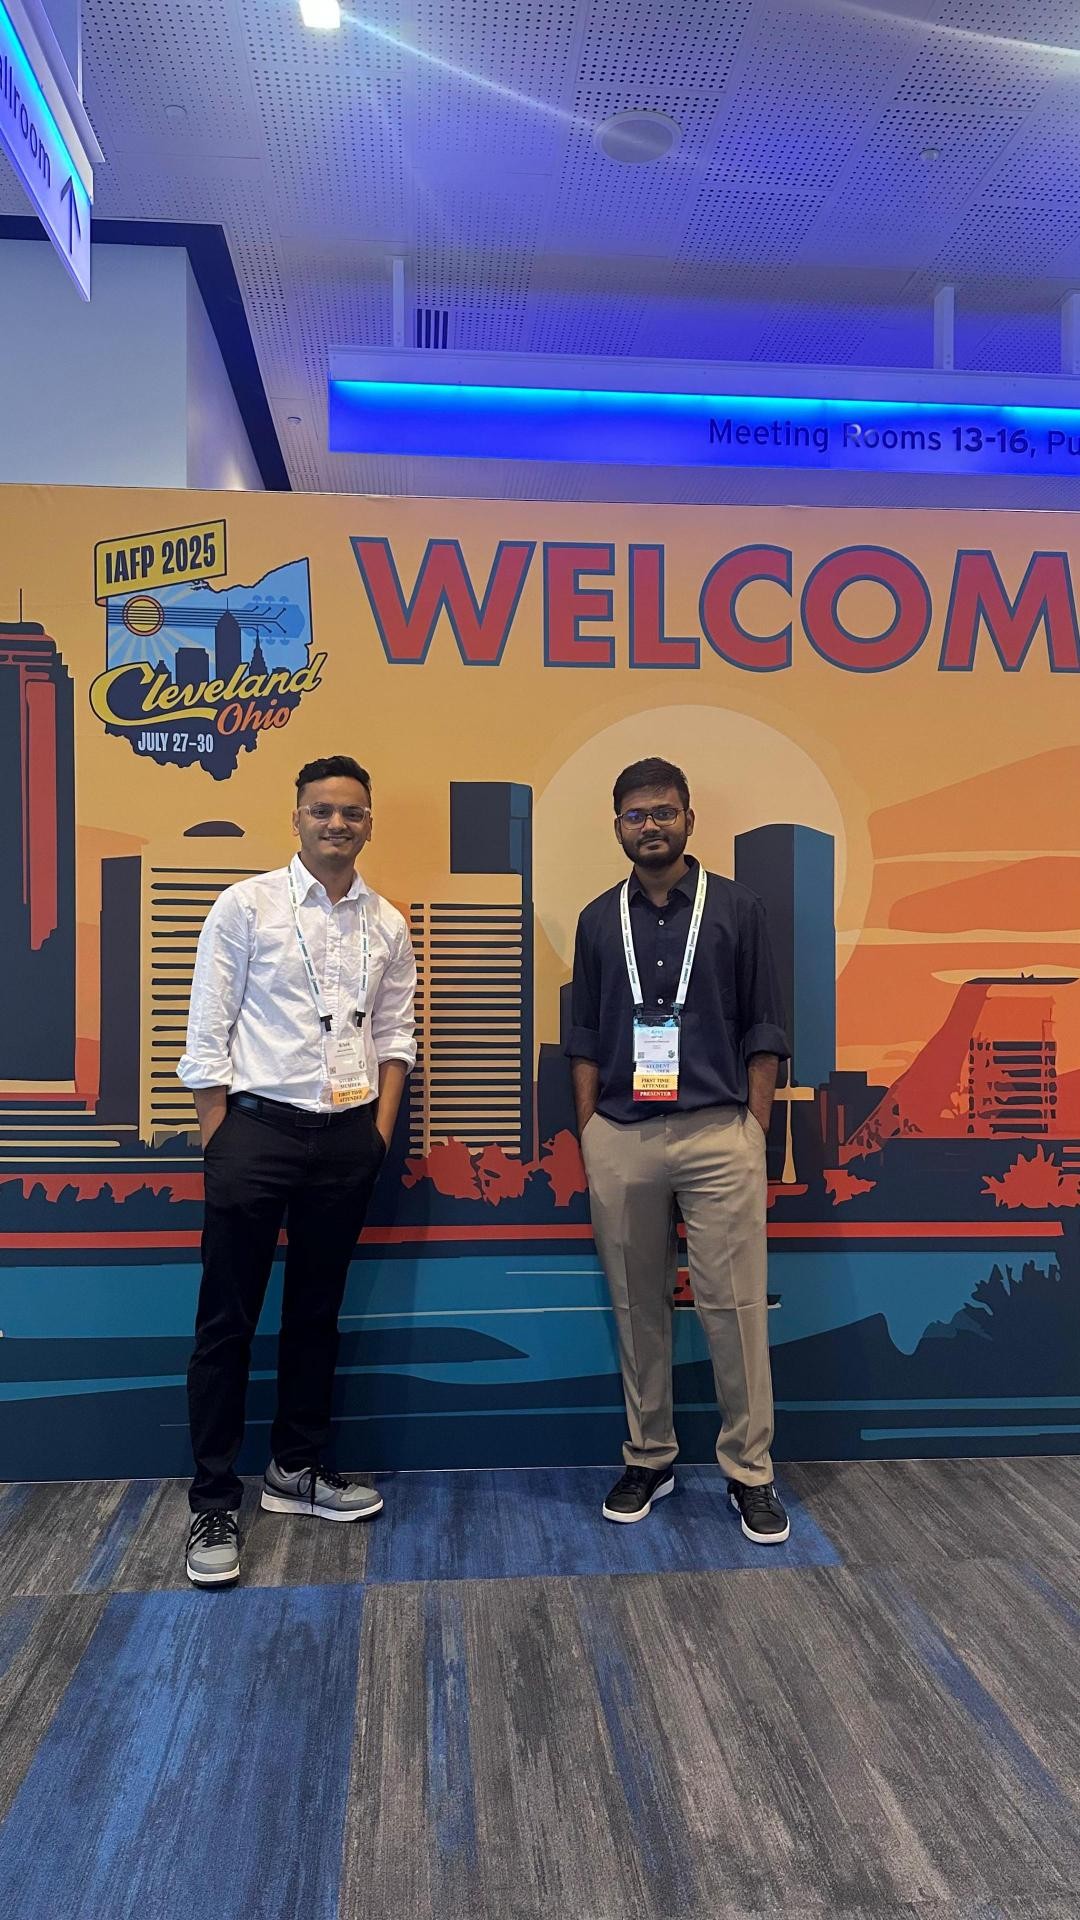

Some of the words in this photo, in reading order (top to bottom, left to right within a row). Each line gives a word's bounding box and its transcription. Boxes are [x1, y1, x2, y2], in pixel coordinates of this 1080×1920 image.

[0, 55, 50, 188] llroom
[708, 418, 829, 452] Meeting
[843, 422, 942, 451] Rooms
[951, 426, 1036, 458] 13-16,
[105, 544, 155, 584] IAFP
[161, 532, 216, 575] 2025
[349, 536, 1080, 673] WELCOM
[89, 652, 328, 726] Cleveland
[137, 731, 169, 752] JULY
[216, 698, 294, 736] Ohio
